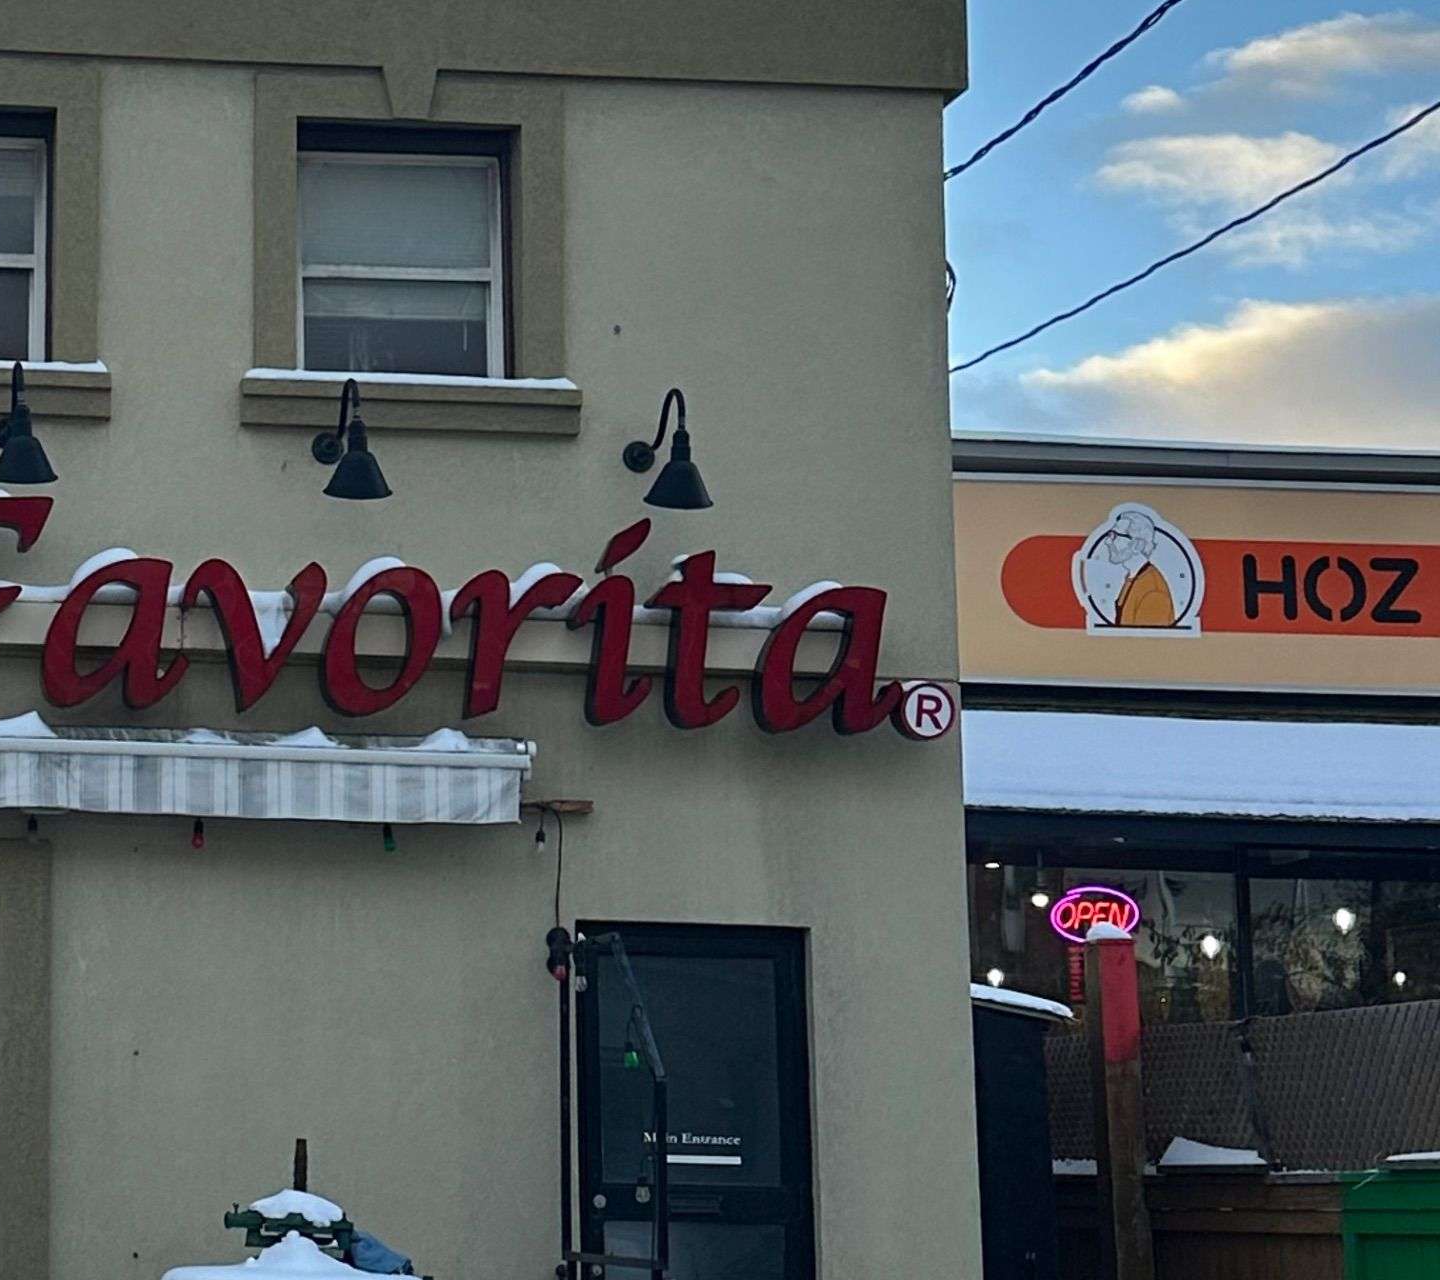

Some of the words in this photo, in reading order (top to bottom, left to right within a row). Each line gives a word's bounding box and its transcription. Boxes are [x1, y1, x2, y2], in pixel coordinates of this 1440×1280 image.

[1242, 553, 1422, 624] HOZ
[1056, 901, 1131, 930] OPEN
[643, 1131, 678, 1143] Min
[682, 1131, 742, 1146] Entrance
